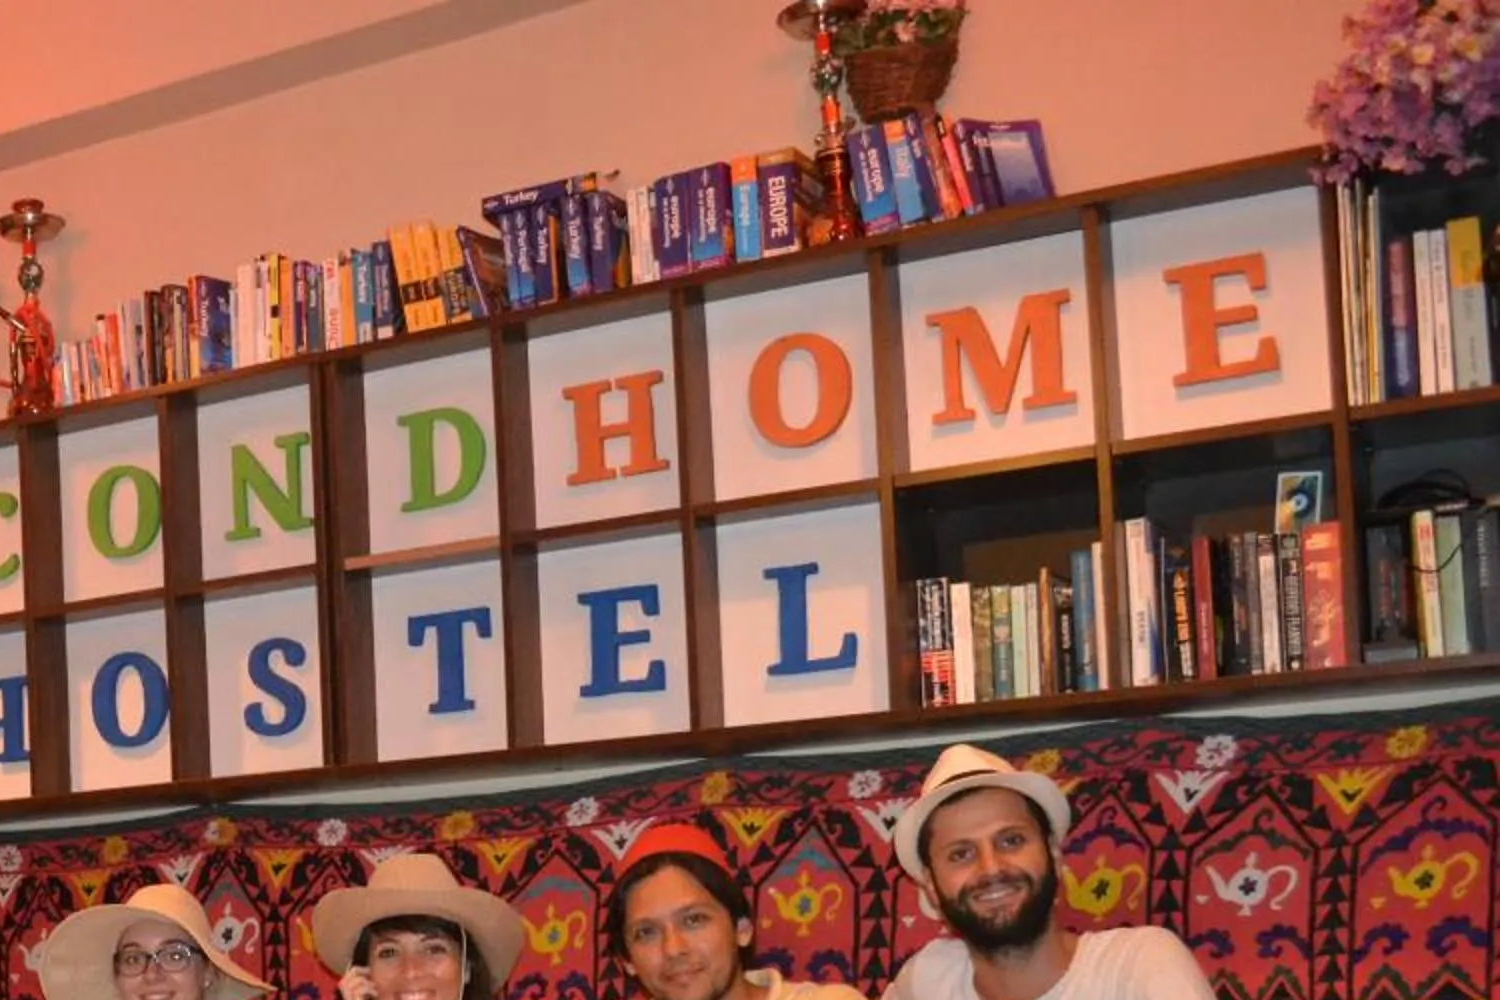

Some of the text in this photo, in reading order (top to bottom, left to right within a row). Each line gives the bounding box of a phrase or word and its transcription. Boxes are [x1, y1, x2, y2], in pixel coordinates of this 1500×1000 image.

[502, 191, 539, 205] Turkey
[767, 175, 789, 239] EUROPE
[567, 216, 582, 259] Turkey
[562, 252, 1281, 487] HOME
